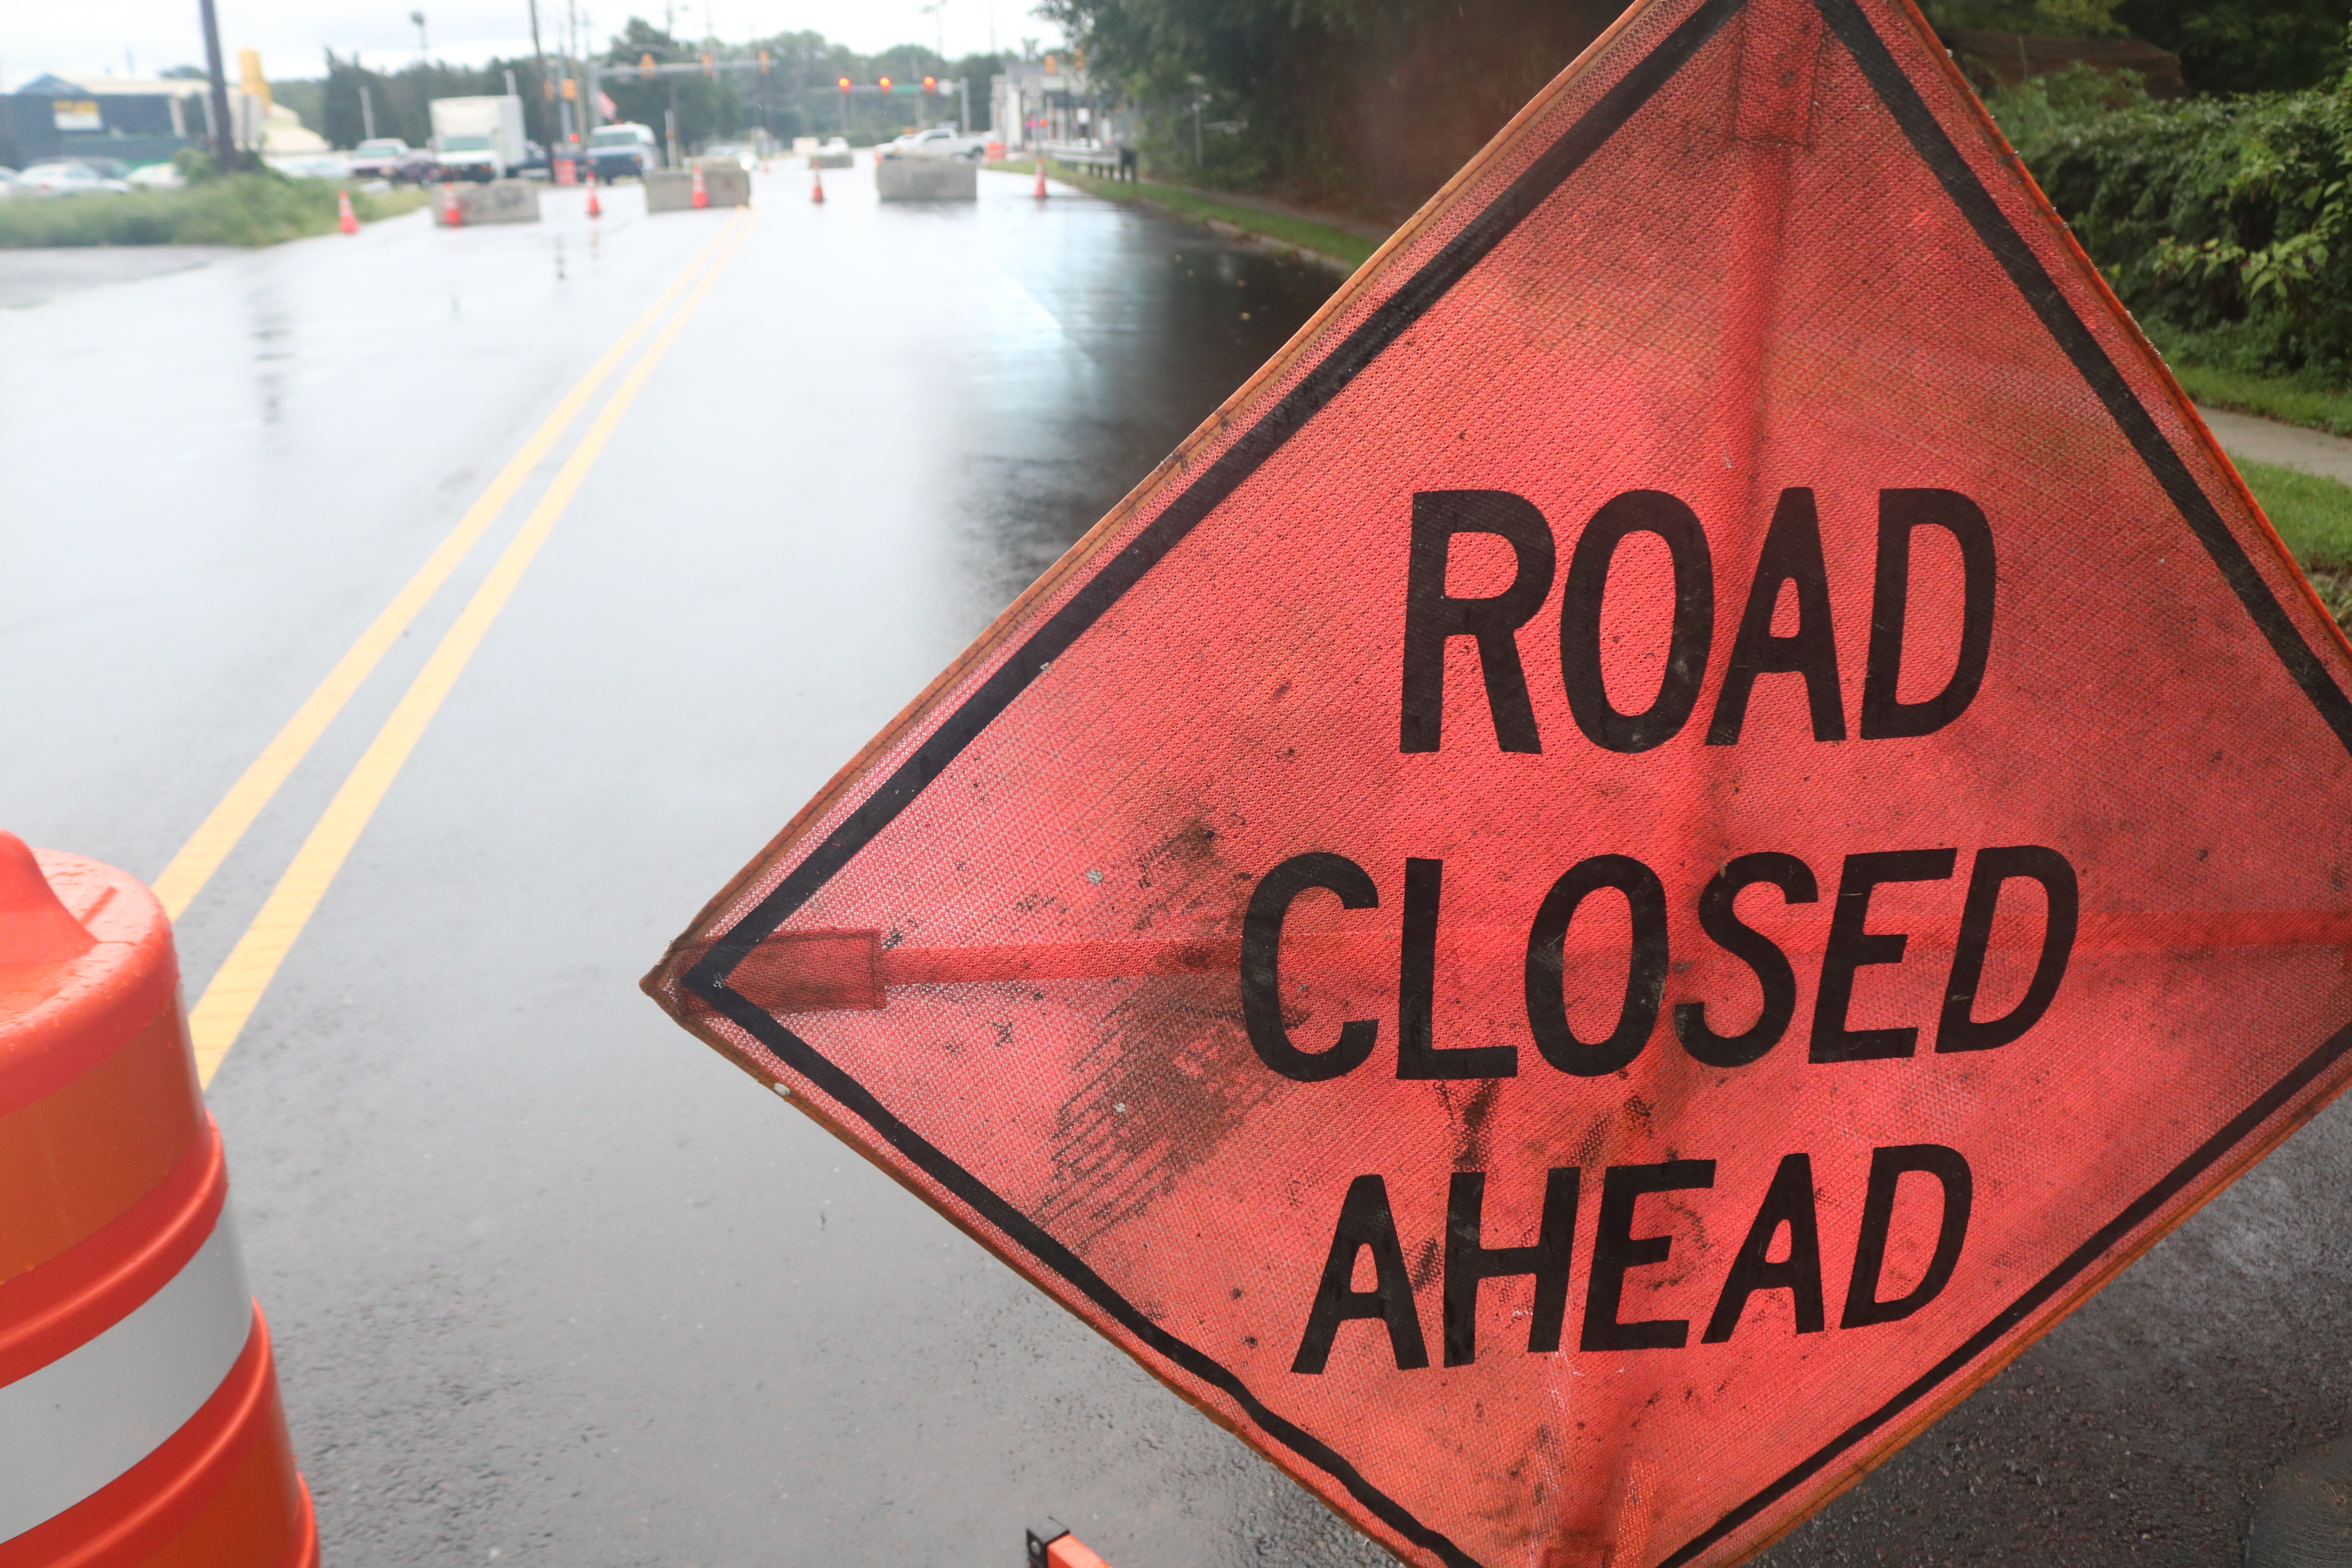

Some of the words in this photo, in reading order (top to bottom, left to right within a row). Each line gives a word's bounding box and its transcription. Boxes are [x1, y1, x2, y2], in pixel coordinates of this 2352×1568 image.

[1400, 487, 1997, 753] ROAD
[1241, 845, 2079, 1081] CLOSED
[1291, 1144, 1973, 1374] AHEAD
